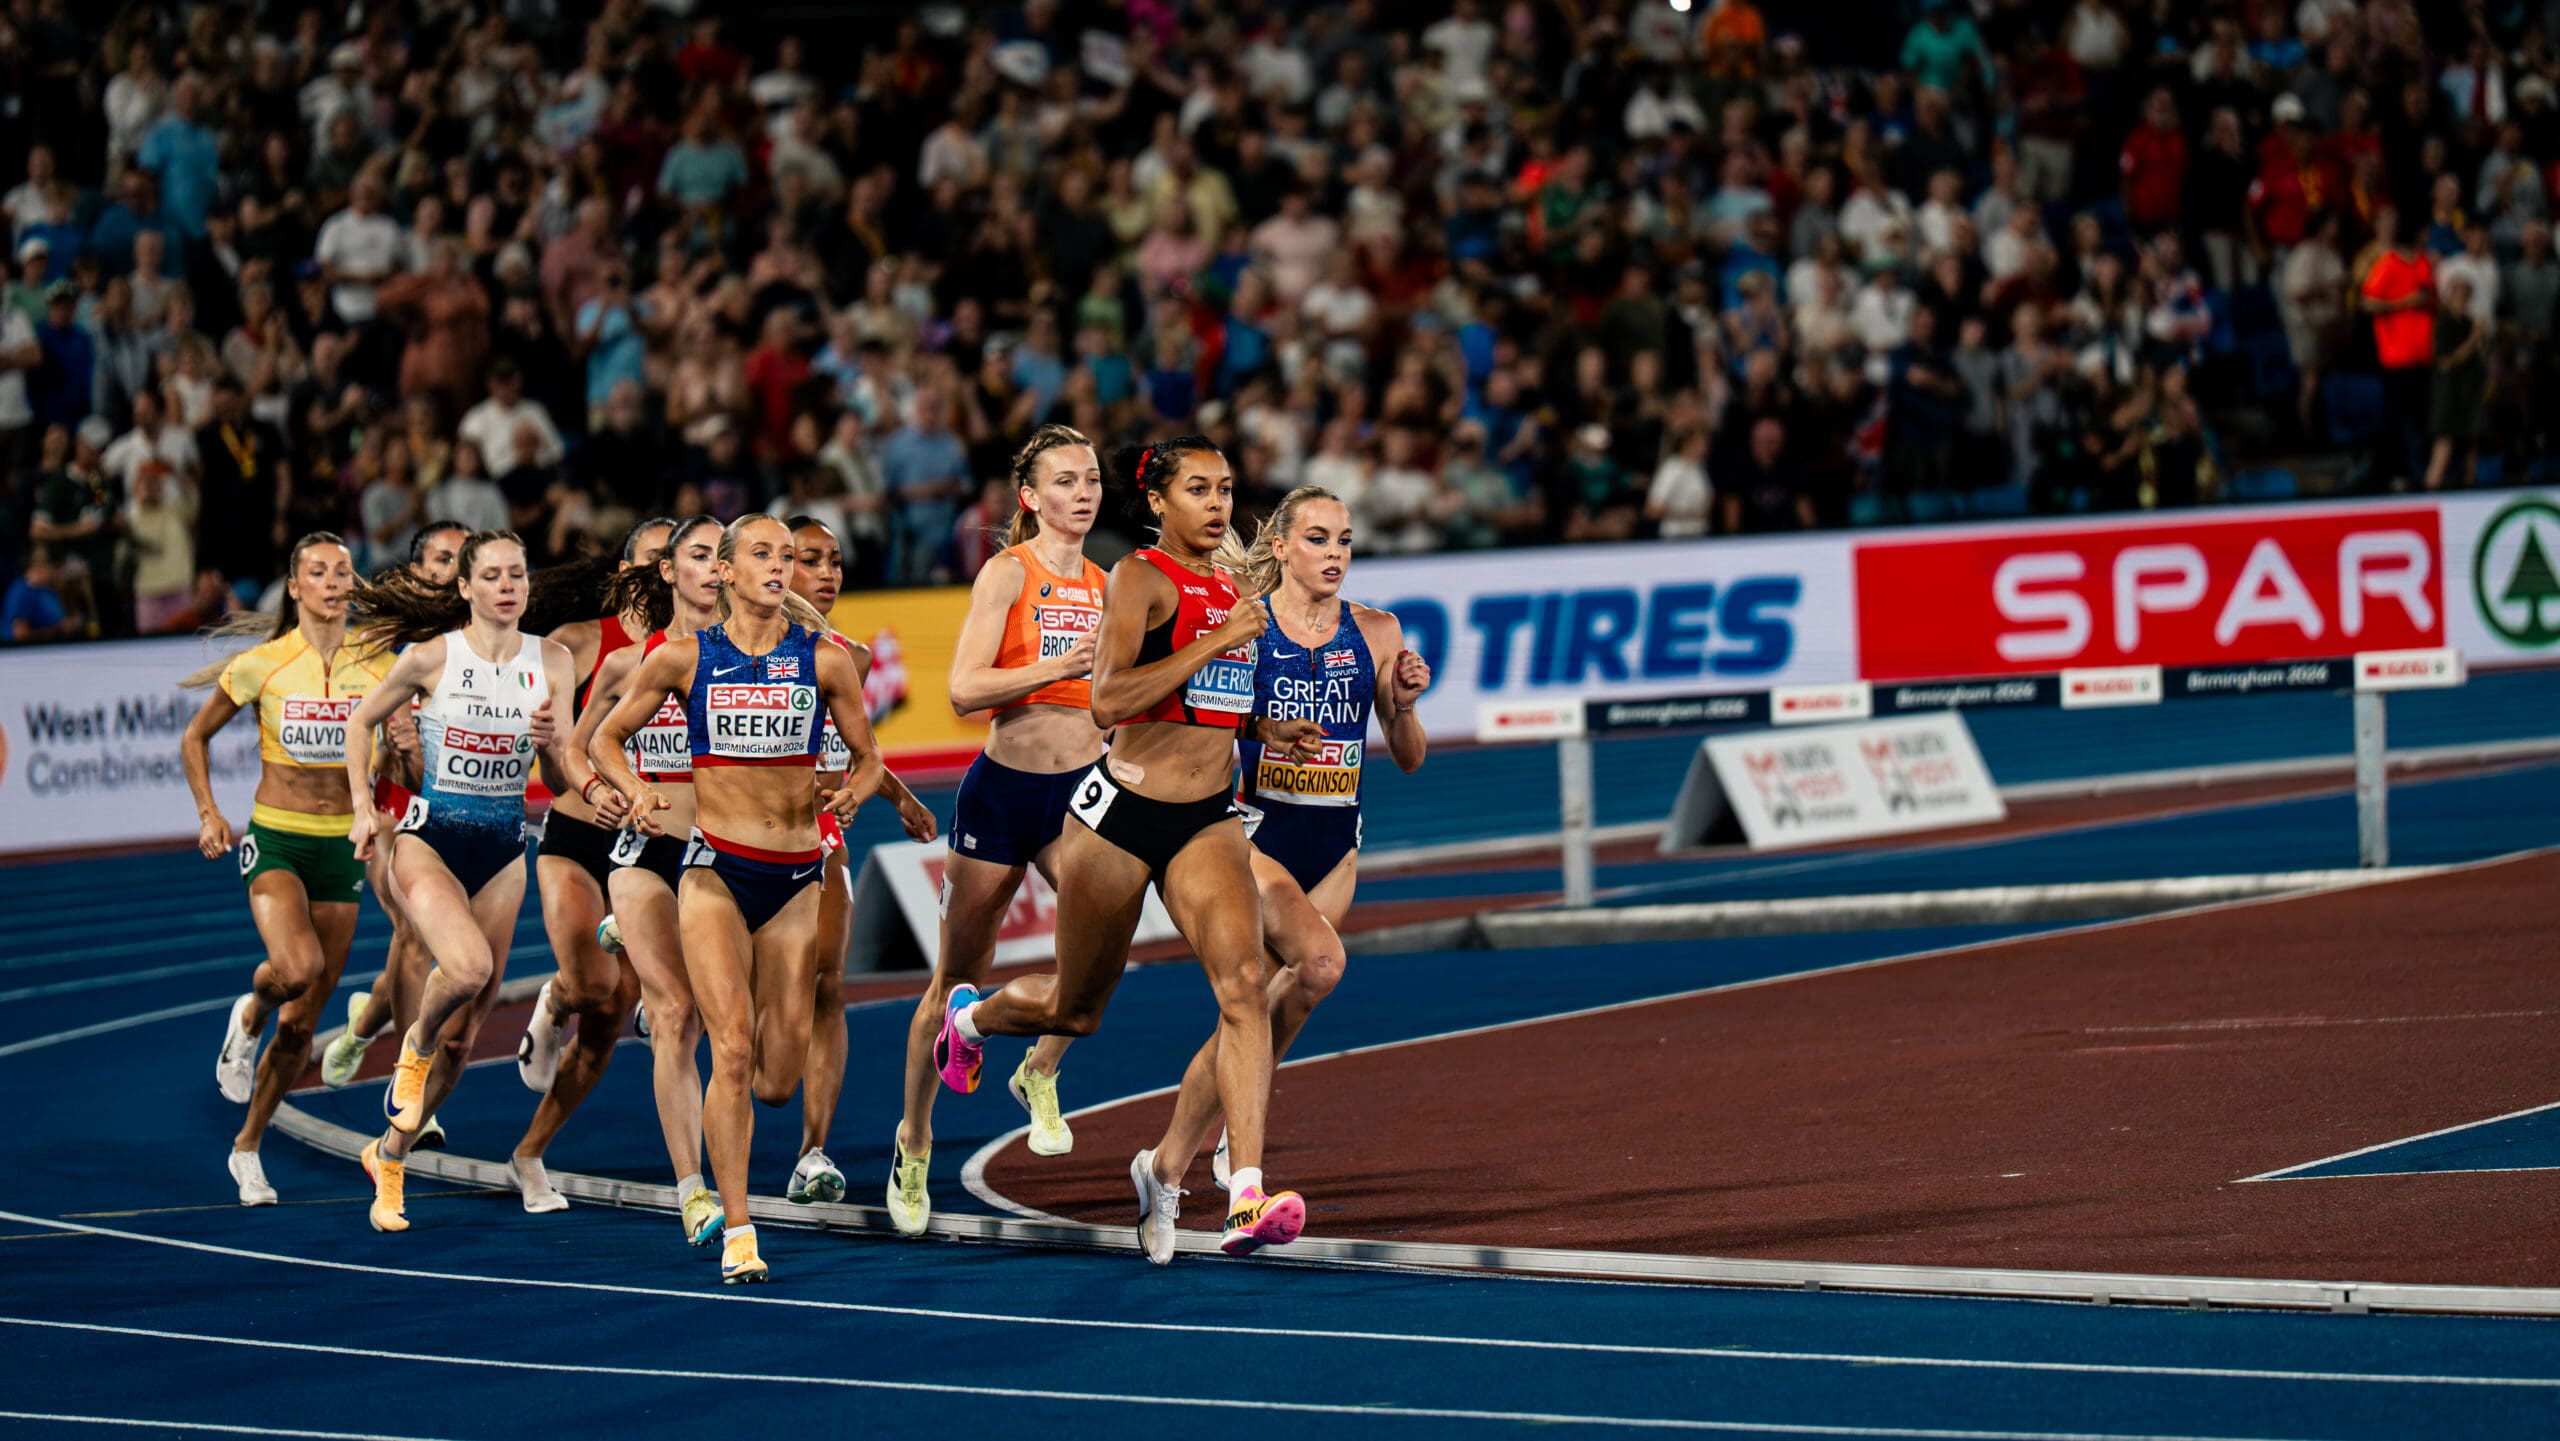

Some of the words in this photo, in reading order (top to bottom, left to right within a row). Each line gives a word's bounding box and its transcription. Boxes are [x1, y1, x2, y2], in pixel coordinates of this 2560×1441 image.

[1993, 529, 2435, 662] SPAR
[1043, 611, 1099, 629] SPAR
[1470, 576, 1800, 690] TIRES
[1194, 665, 1253, 693] WERRO
[1326, 667, 1359, 679] Novuna
[2187, 669, 2284, 692] Birmingham
[712, 689, 787, 707] SPAR
[1273, 676, 1354, 702] GREAT
[285, 702, 349, 720] SPAR
[467, 704, 523, 719] ITALIA
[1267, 701, 1361, 724] BRITAIN
[25, 702, 105, 745] West
[716, 714, 805, 738] REEKIE
[446, 729, 513, 752] SPAR
[714, 742, 782, 753] BIRMINGHAM
[783, 742, 805, 752] 2026
[447, 754, 522, 780] COIRO
[438, 778, 502, 792] BIRMINGHAM
[503, 782, 525, 791] 2026
[1259, 765, 1358, 794] HODGKINSON
[1079, 781, 1103, 811] 9
[619, 829, 638, 858] 8
